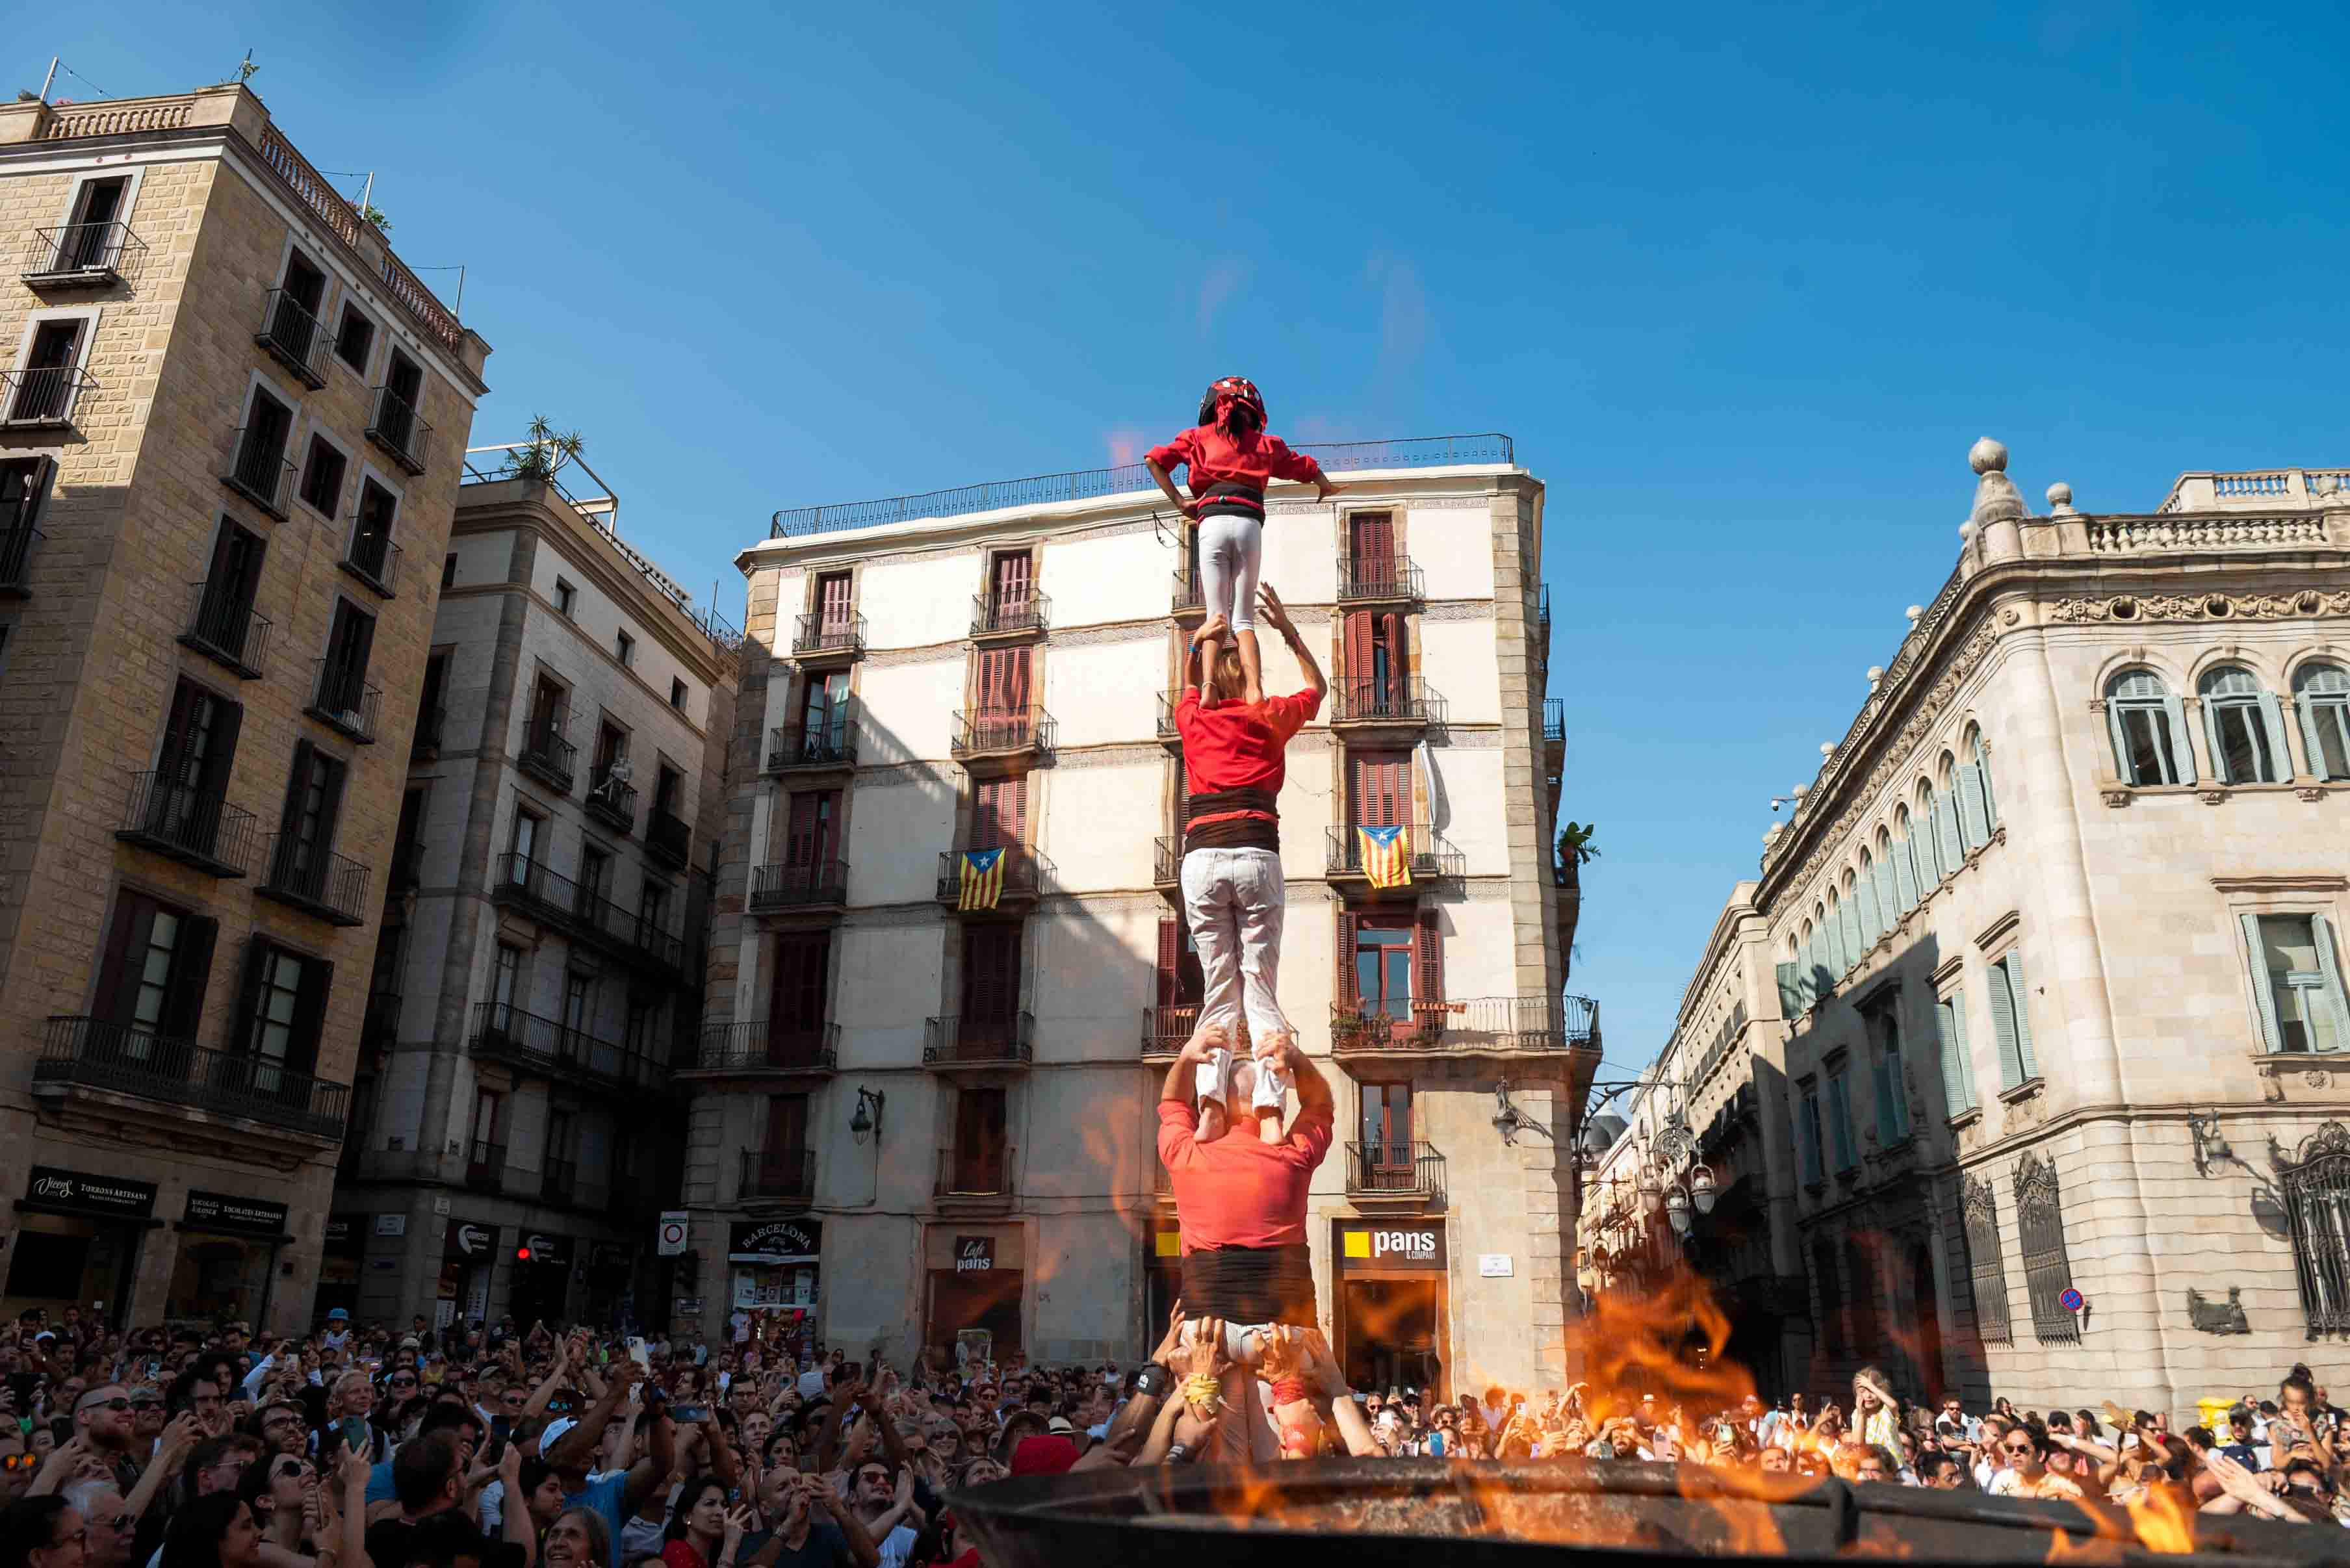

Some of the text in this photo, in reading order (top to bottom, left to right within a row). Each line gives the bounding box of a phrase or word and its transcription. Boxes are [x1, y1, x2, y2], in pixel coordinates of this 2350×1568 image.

[81, 1183, 113, 1196] TORRONS
[112, 1189, 147, 1200] ARTESANS
[742, 1224, 811, 1248] BARCELONA
[1374, 1231, 1436, 1257] pans
[1406, 1251, 1411, 1259] &
[957, 1258, 990, 1273] pans
